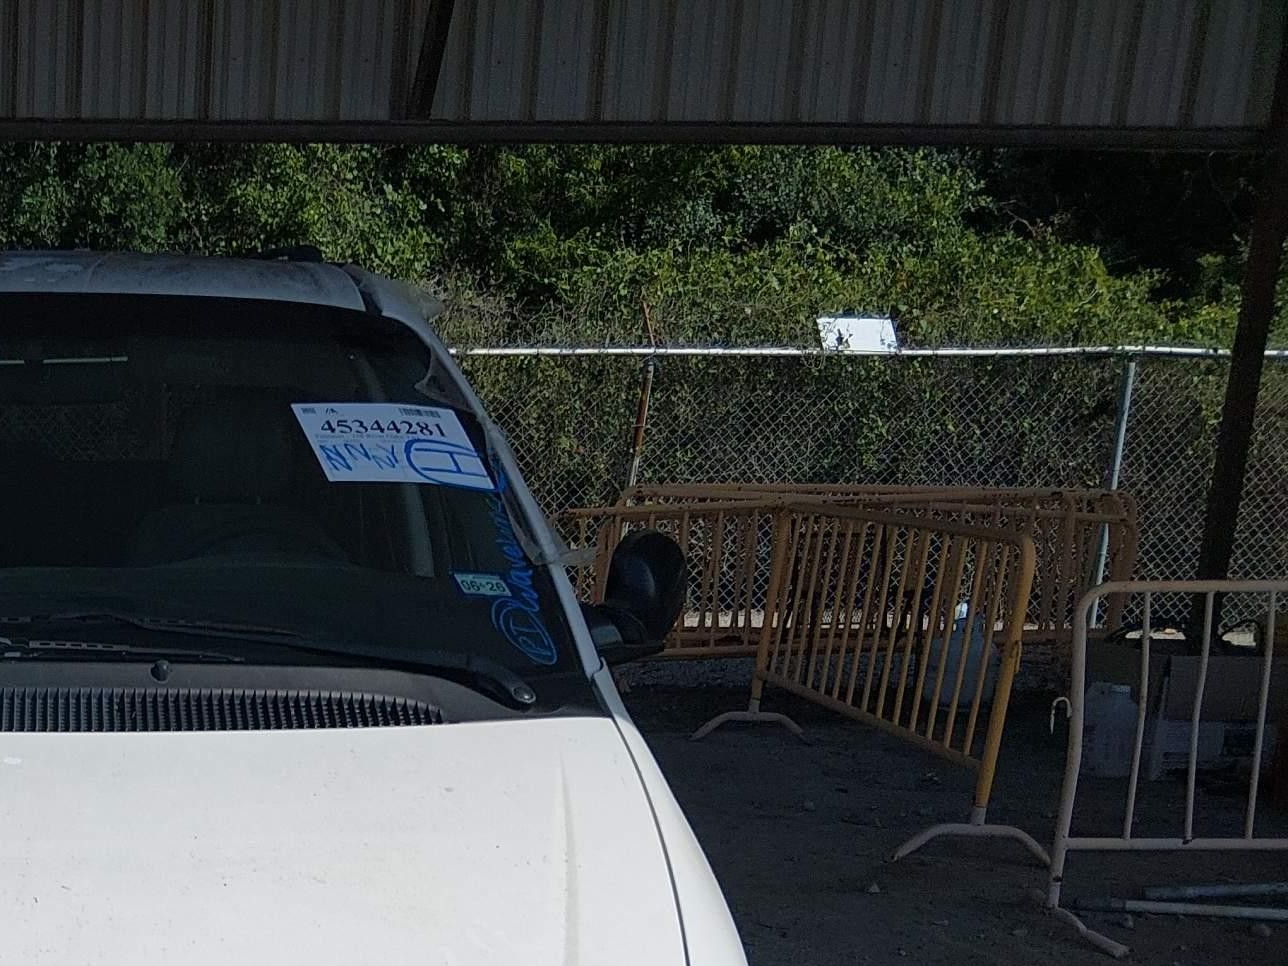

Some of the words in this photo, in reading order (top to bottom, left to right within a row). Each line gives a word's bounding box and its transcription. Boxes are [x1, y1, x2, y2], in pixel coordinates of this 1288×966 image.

[321, 419, 446, 437] 45344281
[461, 580, 480, 591] 06
[486, 582, 506, 592] 26
